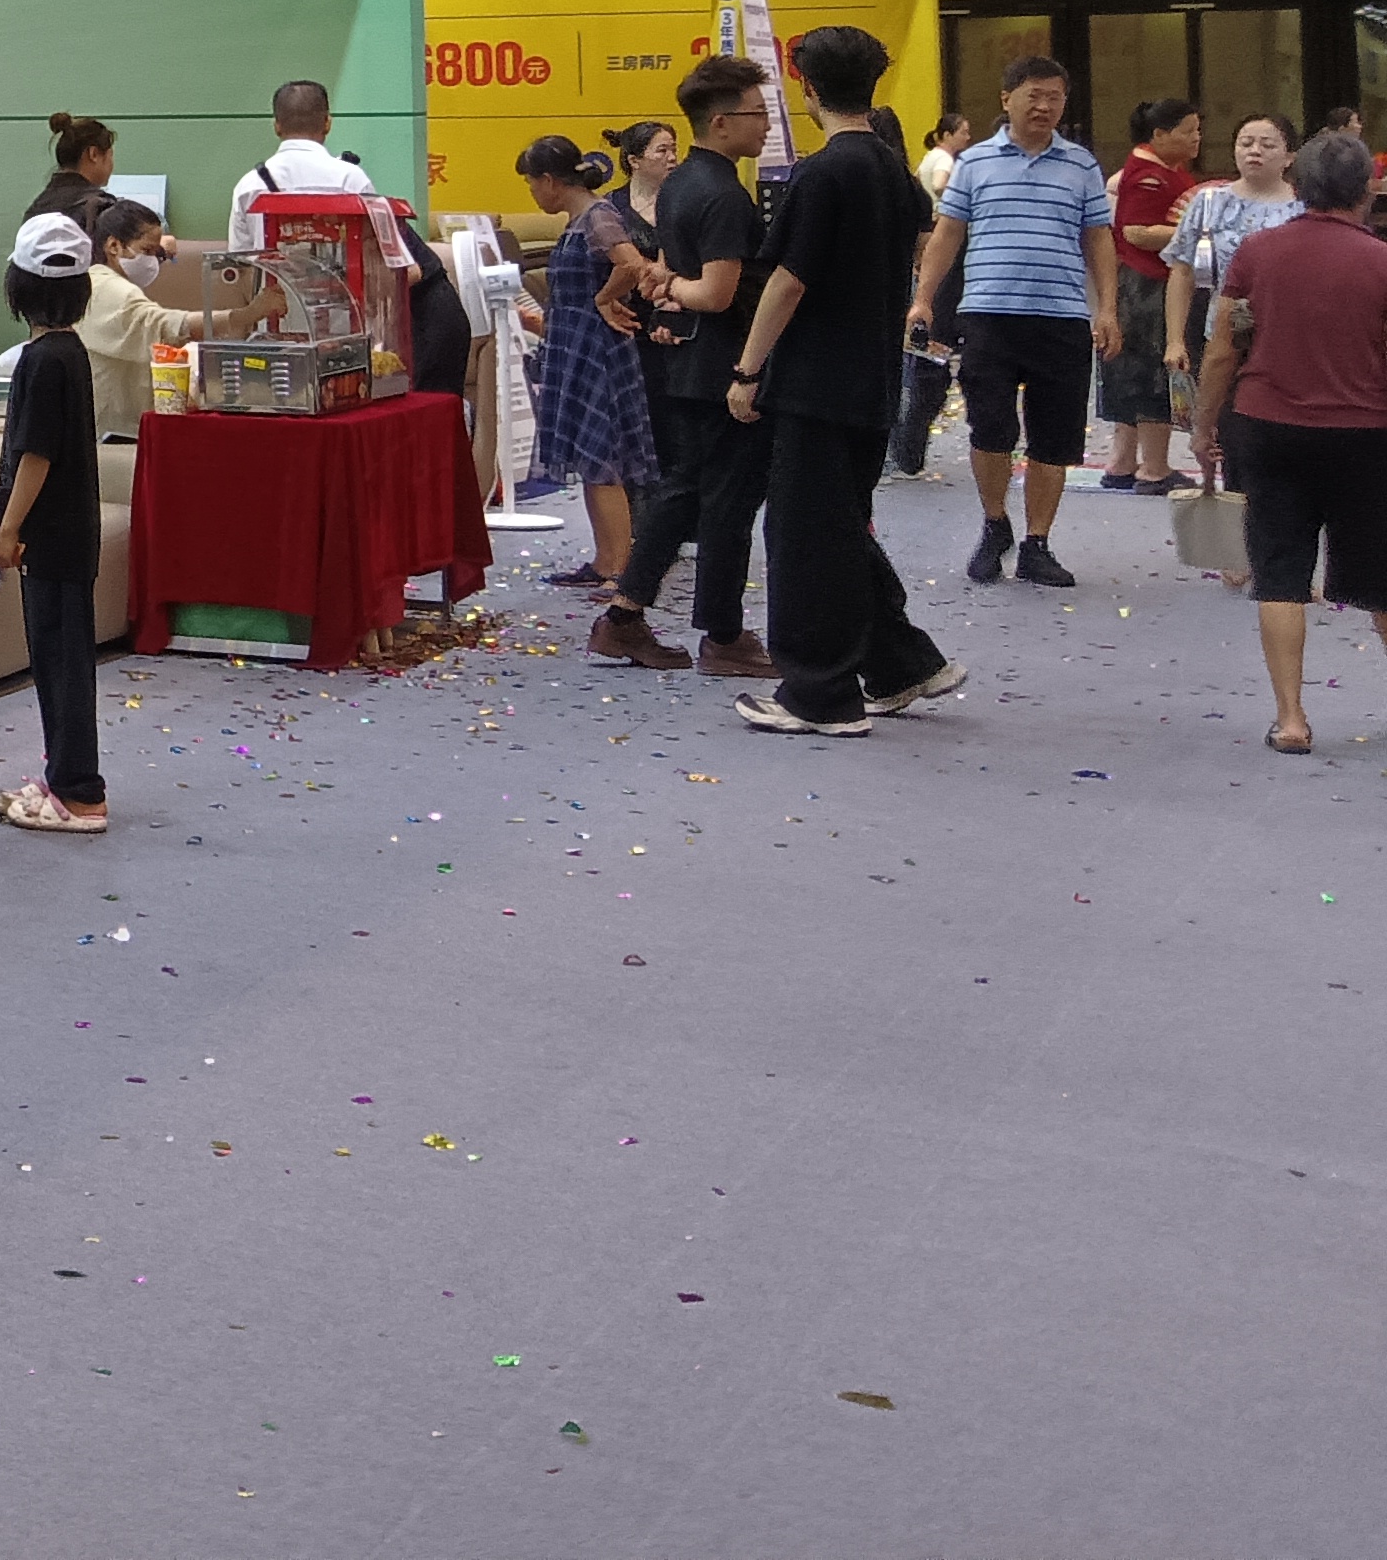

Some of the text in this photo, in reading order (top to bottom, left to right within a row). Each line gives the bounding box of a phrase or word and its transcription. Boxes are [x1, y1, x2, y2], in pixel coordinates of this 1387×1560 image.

[425, 40, 524, 87] 800
[605, 54, 672, 71] 三房两厅
